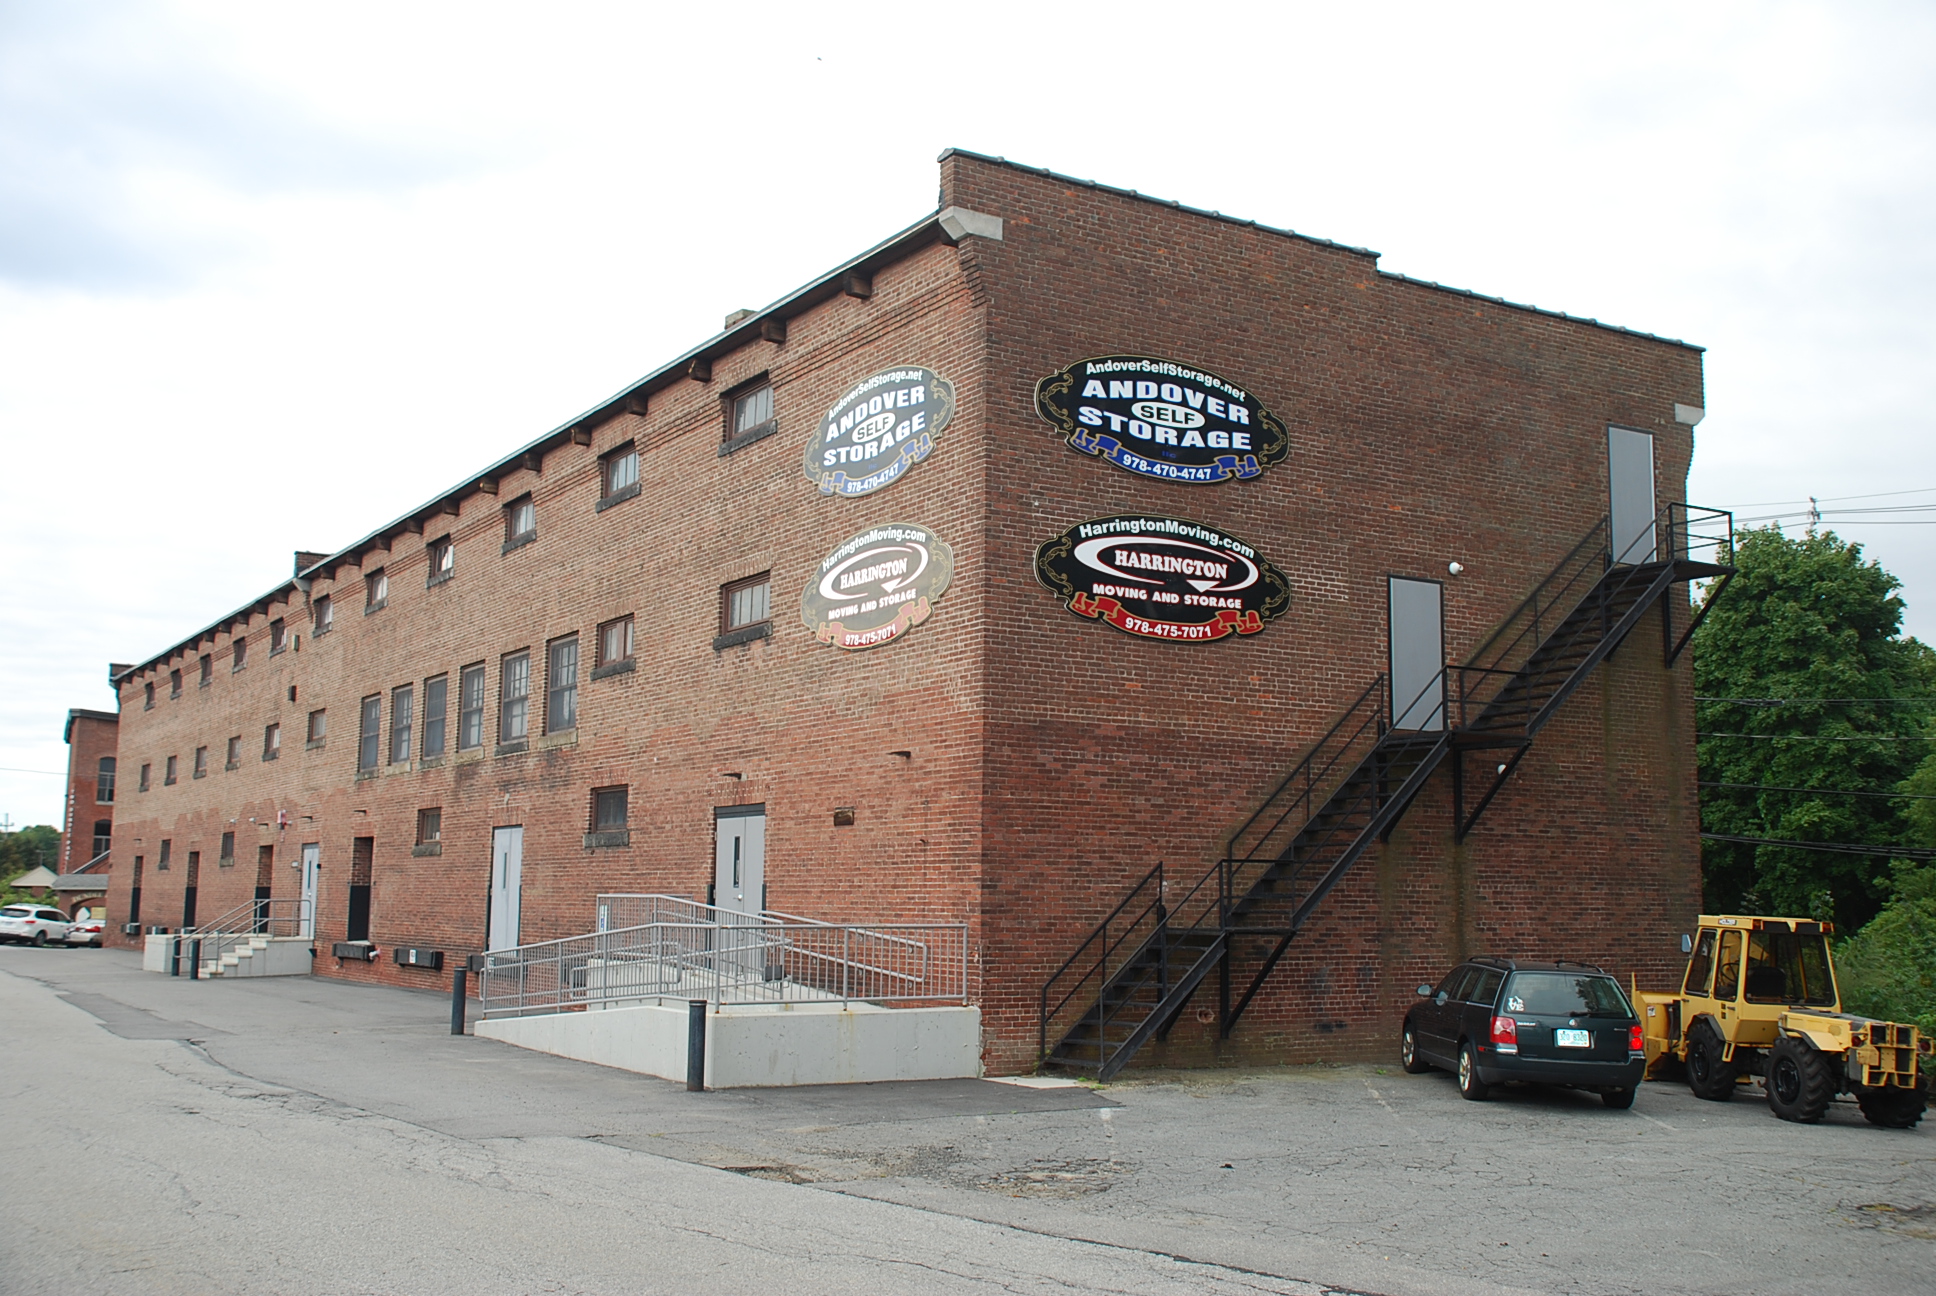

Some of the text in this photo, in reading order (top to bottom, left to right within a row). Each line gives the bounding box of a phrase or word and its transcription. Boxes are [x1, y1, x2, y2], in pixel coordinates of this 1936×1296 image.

[828, 369, 923, 421] AndoverSelfStorage.net
[1086, 359, 1246, 402] AndoverSelfStorage.net
[825, 385, 925, 443] ANDOVER
[1081, 379, 1250, 426] ANDOVER
[1140, 404, 1196, 425] SELF
[823, 411, 926, 467] STORAGE
[857, 416, 891, 441] SELF
[1078, 405, 1252, 450] STORAGE
[847, 463, 899, 493] 978-470-4747
[1123, 454, 1212, 480] 978-470-4747
[822, 527, 926, 572] HarringtonMoving.com
[1079, 518, 1255, 558] HarringtonMoving.com
[840, 557, 908, 590] HARRINGTON
[1114, 549, 1228, 579] HARRINGTON
[828, 588, 916, 620] MOVING AND STORAGE
[1092, 583, 1242, 609] MOVING AND STORAGE
[845, 624, 897, 646] 978-475-7071
[1125, 617, 1212, 638] 978-475-7071
